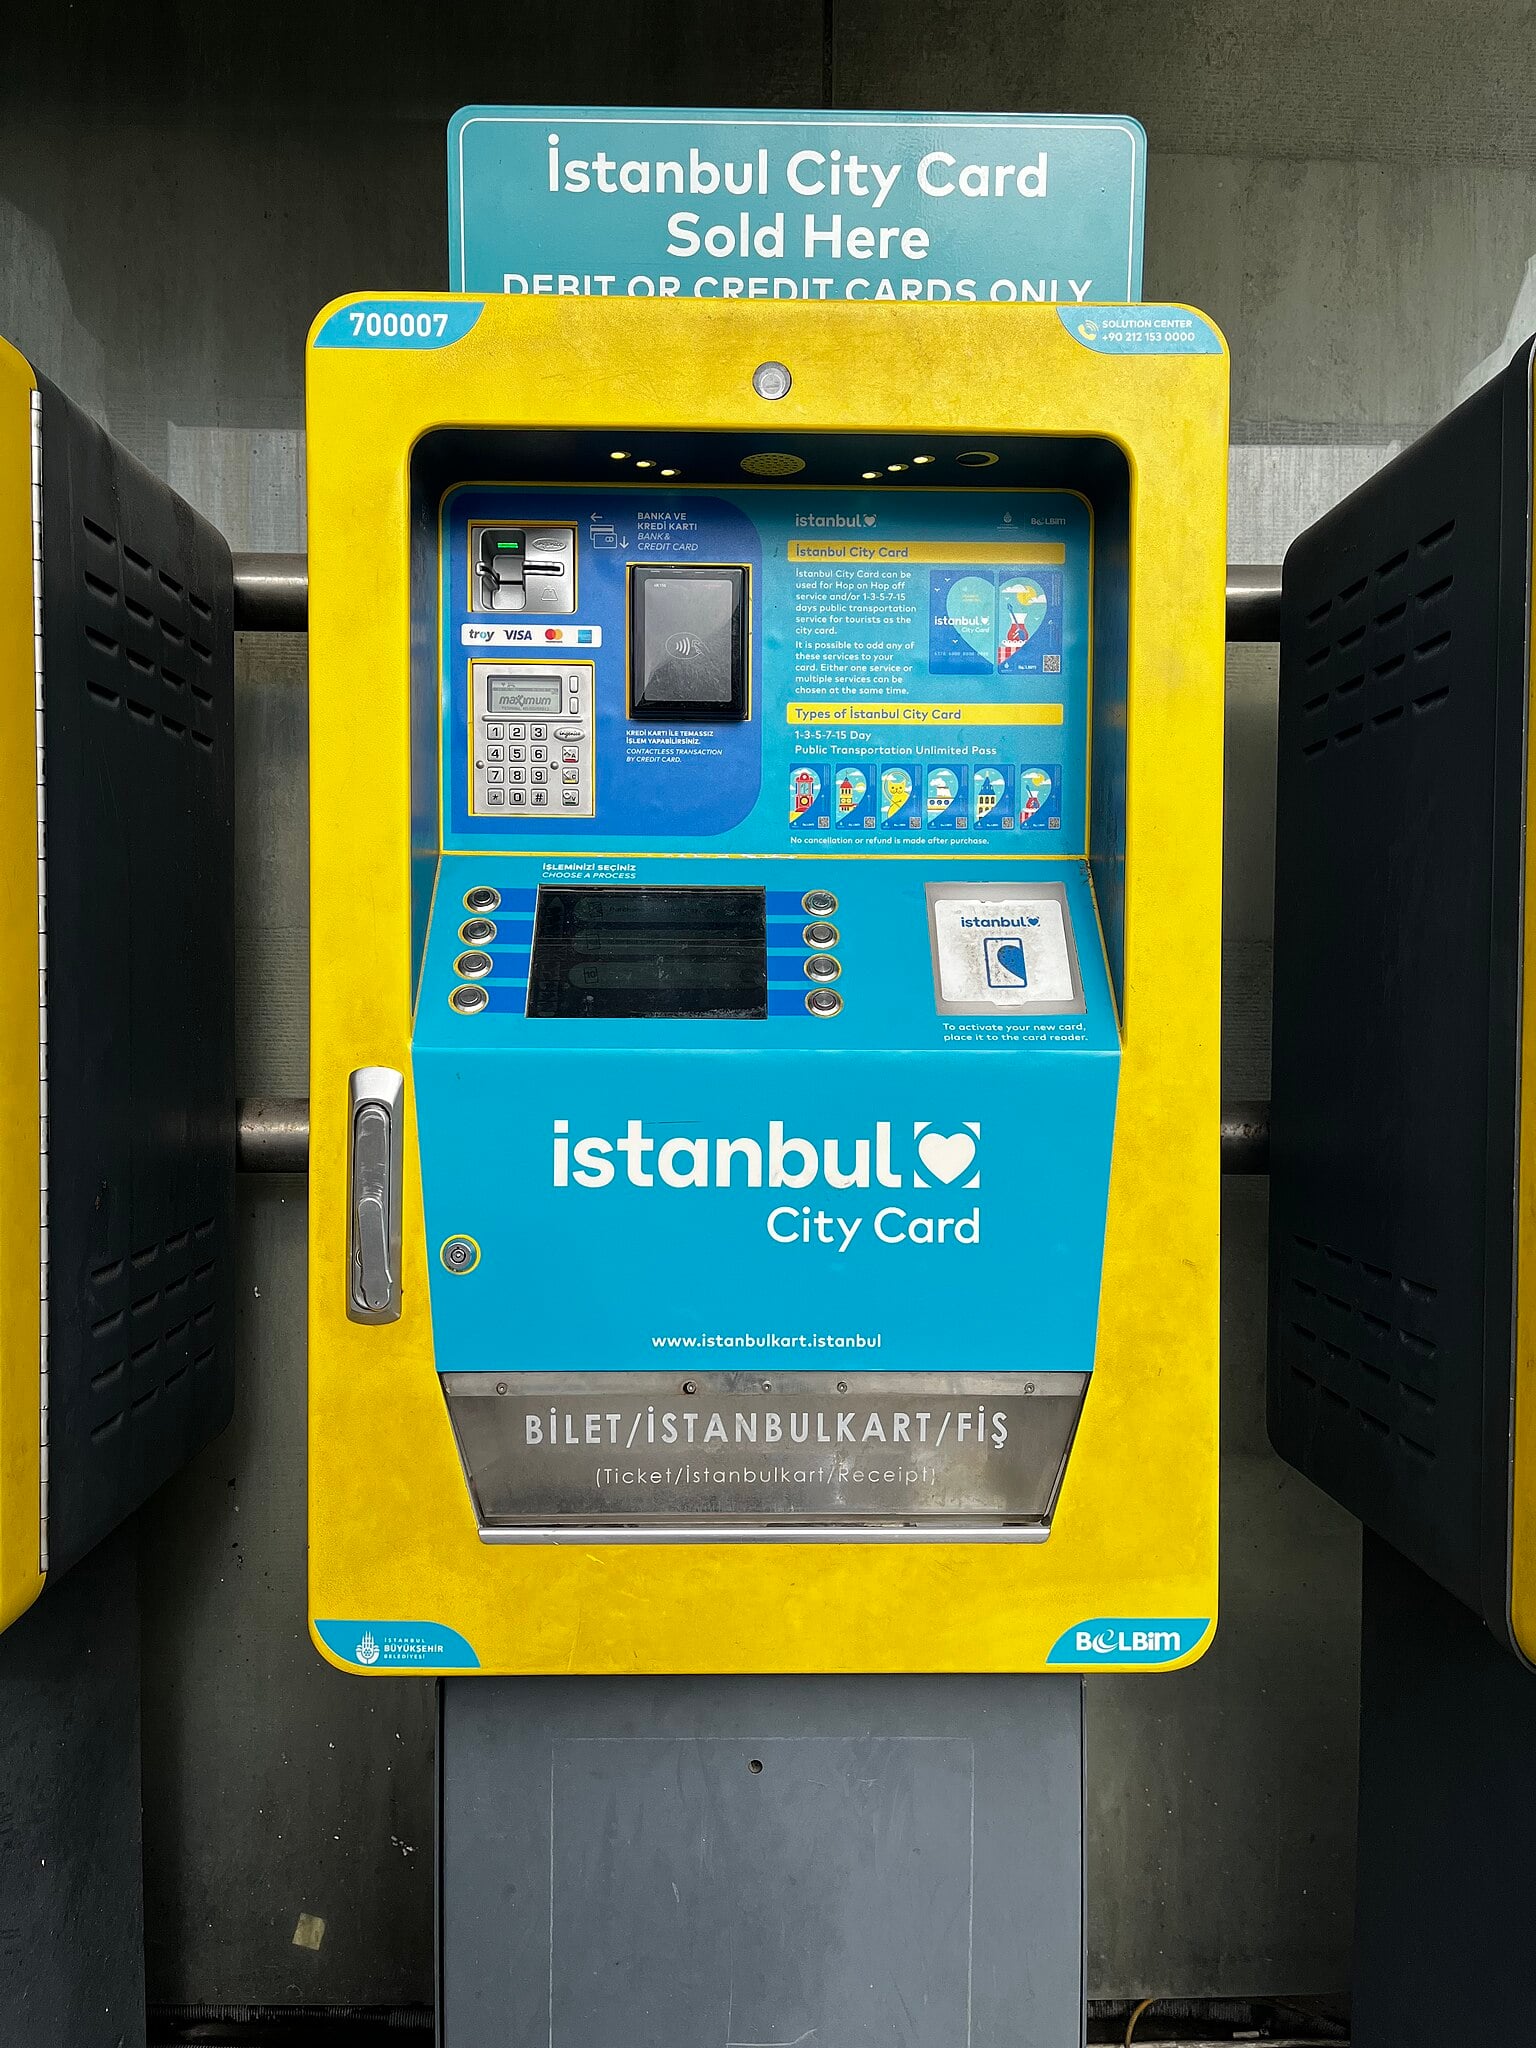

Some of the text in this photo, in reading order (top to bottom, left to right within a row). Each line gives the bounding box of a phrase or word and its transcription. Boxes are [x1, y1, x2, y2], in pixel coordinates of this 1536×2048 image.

[547, 134, 1048, 207] İstanbul City Card
[666, 211, 930, 260] Sold Here
[350, 312, 449, 338] 700007
[1102, 319, 1193, 328] SOLUTION CENTER
[1102, 332, 1195, 342] +90 212 153 0000
[637, 512, 687, 521] BANKA VE
[795, 513, 861, 527] istanbul
[637, 520, 698, 531] KREDİ KARTI
[637, 543, 698, 551] CREDIT CARD
[795, 543, 909, 560] İstanbul City Card
[795, 567, 833, 578] İstanbul
[835, 569, 854, 579] City
[856, 570, 879, 578] Card
[900, 571, 912, 579] be
[795, 581, 817, 589] used
[819, 581, 833, 589] for
[835, 582, 855, 590] Hop
[870, 582, 890, 591] Hop
[891, 581, 906, 590] off
[795, 592, 906, 601] service and/or 1-3-5-7-15
[795, 603, 917, 614] days public transportation
[795, 615, 826, 623] service
[829, 615, 842, 623] for
[845, 615, 881, 624] tourists
[895, 616, 912, 624] the
[934, 616, 979, 626] istanbul
[468, 628, 533, 642] troy VISA
[795, 626, 838, 635] city card.
[795, 641, 803, 649] It
[805, 641, 813, 649] is
[814, 641, 852, 651] possible
[866, 641, 884, 649] add
[885, 643, 903, 651] any
[904, 641, 915, 649] of
[795, 652, 894, 662] these services to your
[795, 664, 818, 672] card.
[820, 663, 849, 672] Either
[869, 664, 901, 672] service
[795, 674, 833, 684] multiple
[834, 675, 871, 684] services
[891, 675, 904, 684] be
[795, 686, 910, 695] chosen at the same time.
[795, 705, 962, 721] Types of İstanbul City Card
[492, 727, 499, 737] 1
[512, 727, 521, 737] 2
[534, 728, 543, 737] 3
[794, 730, 872, 742] 1-3-5-7-15 Day
[491, 749, 499, 758] 4
[513, 749, 521, 758] 5
[534, 749, 543, 758] 6
[795, 744, 997, 757] Public Transportation Unlimited Pass
[491, 771, 499, 780] 7
[513, 771, 521, 780] 8
[535, 771, 543, 780] 9
[790, 836, 803, 844] No
[804, 836, 855, 845] cancellation
[865, 836, 894, 845] refund
[894, 836, 901, 845] is
[902, 836, 926, 845] made
[927, 836, 948, 845] after
[950, 837, 990, 847] purchase.
[960, 916, 1025, 928] istanbul
[943, 1022, 956, 1030] To
[958, 1023, 1004, 1031] activate
[1005, 1024, 1031, 1032] your
[1058, 1023, 1087, 1031] card,
[943, 1034, 973, 1042] place
[553, 1119, 902, 1189] istanbul
[766, 1205, 981, 1253] City Card
[651, 1333, 882, 1350] www.istanbulkart.istanbul
[525, 1405, 1010, 1449] BİLET/İSTANBULKART/FİŞ
[383, 1643, 444, 1654] BÜYÜKŞEHİR
